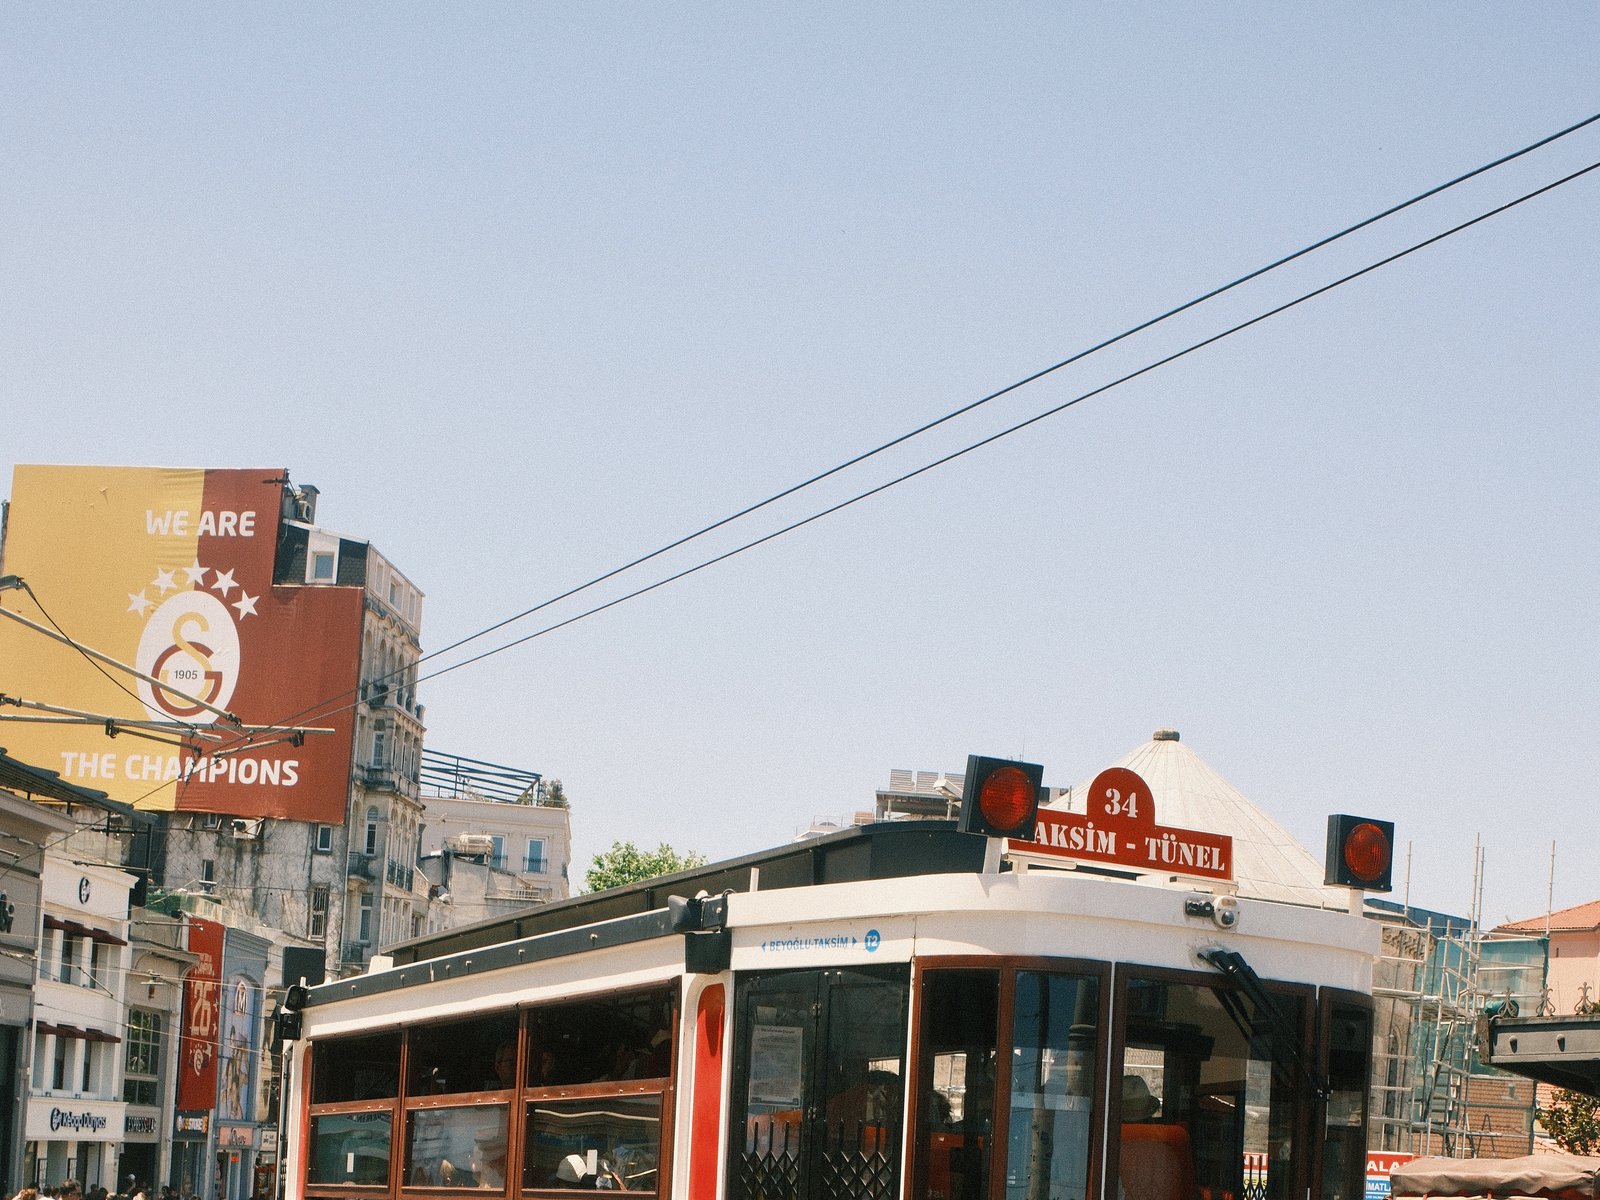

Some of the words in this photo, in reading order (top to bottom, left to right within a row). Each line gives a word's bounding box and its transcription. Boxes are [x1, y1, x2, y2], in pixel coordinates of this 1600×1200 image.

[145, 509, 189, 536] WE
[196, 510, 256, 537] ARE
[174, 669, 198, 680] 1905
[61, 752, 117, 779] THE
[125, 754, 299, 787] CHAMPIONS
[1104, 788, 1138, 818] 34
[1033, 821, 1116, 855] AKSİM
[1145, 832, 1225, 871] TÜNEL
[769, 934, 848, 952] BEYOĞLU-TAKSİM
[866, 935, 878, 948] T2
